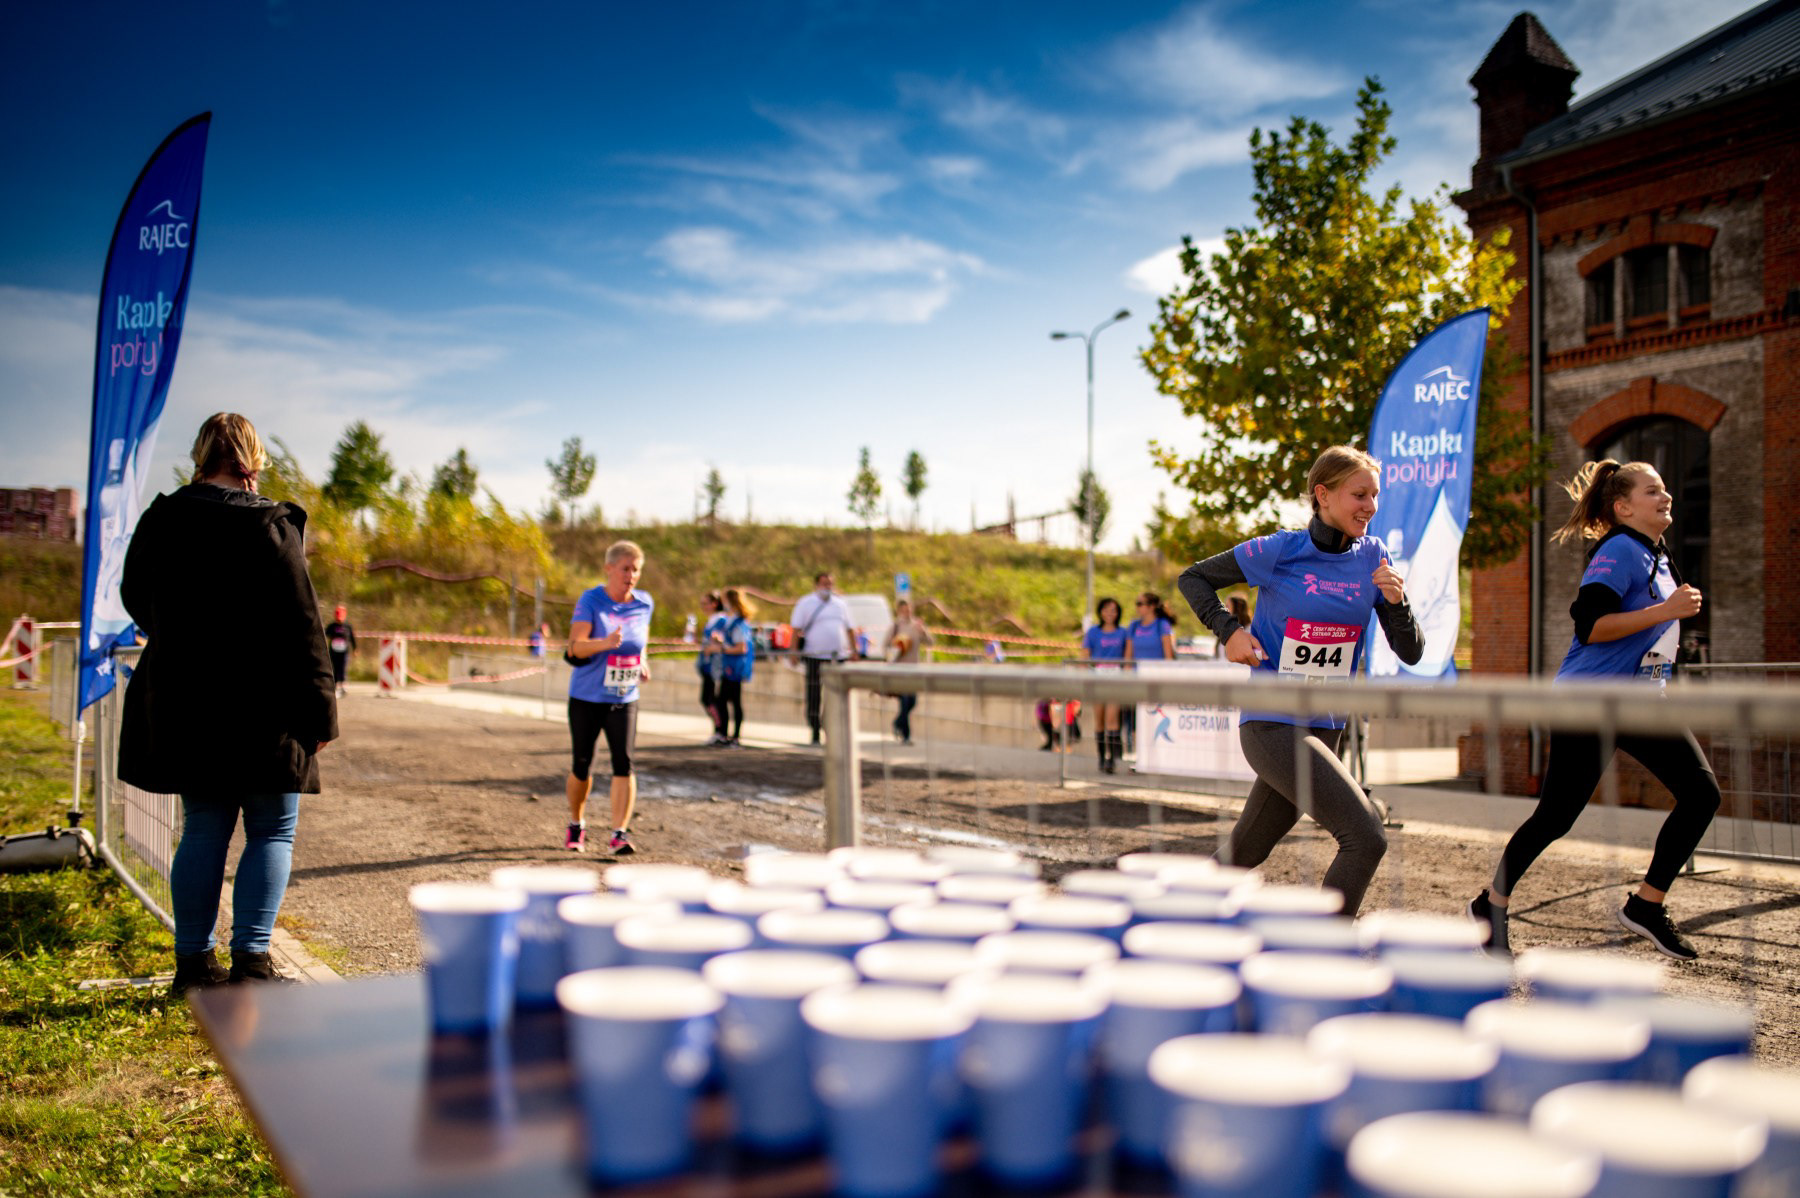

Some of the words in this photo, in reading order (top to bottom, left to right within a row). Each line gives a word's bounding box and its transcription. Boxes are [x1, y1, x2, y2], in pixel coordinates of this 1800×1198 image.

[139, 222, 190, 255] RAJEC
[116, 291, 175, 337] Kapk
[111, 333, 164, 377] pohy
[1414, 380, 1471, 406] RAJEC
[1294, 644, 1342, 668] 944
[1178, 714, 1230, 732] OSTRAVA
